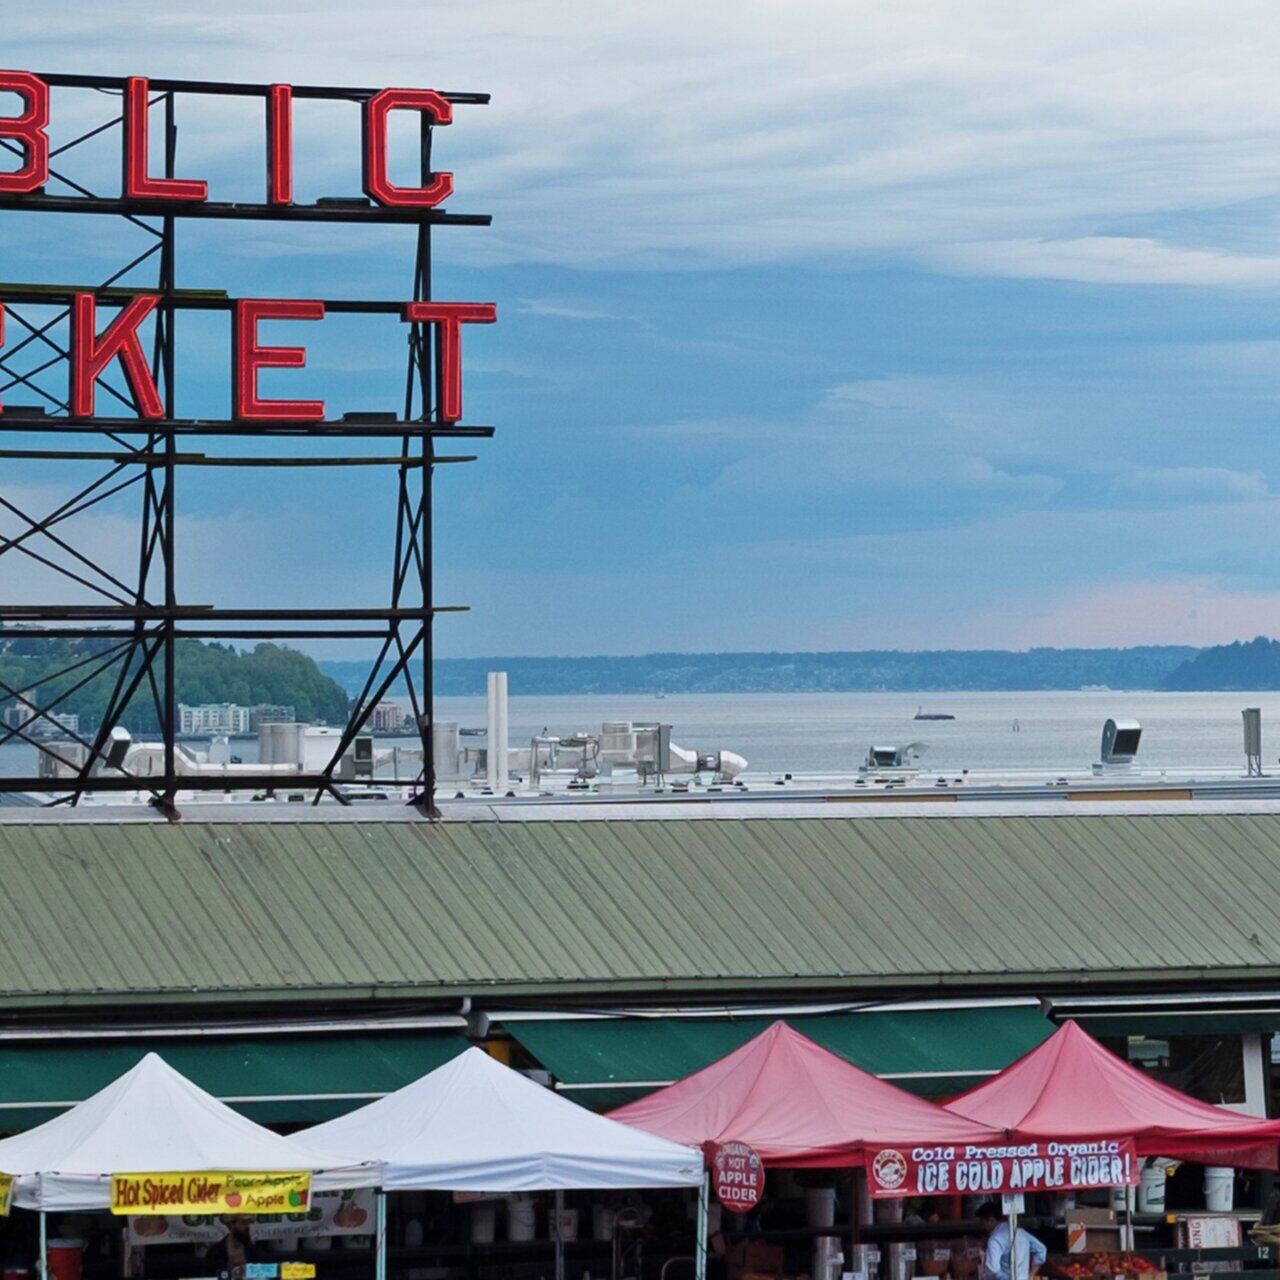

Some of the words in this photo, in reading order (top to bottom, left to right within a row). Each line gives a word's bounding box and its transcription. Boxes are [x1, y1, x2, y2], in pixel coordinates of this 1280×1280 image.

[911, 1147, 955, 1162] Cold
[965, 1143, 1038, 1160] Pressed
[1047, 1140, 1120, 1157] Organic
[728, 1157, 746, 1169] HOT
[718, 1170, 757, 1187] APPLE
[916, 1161, 950, 1193] ICE
[955, 1160, 1005, 1192] COLD
[1010, 1157, 1065, 1188] APPLE
[1070, 1153, 1132, 1186] CIDER!
[115, 1179, 140, 1208] Hot
[143, 1177, 185, 1210] Spiced
[187, 1176, 221, 1205] Cider
[245, 1192, 285, 1208] Apple
[718, 1185, 758, 1202] CIDER
[1257, 1247, 1269, 1259] 12
